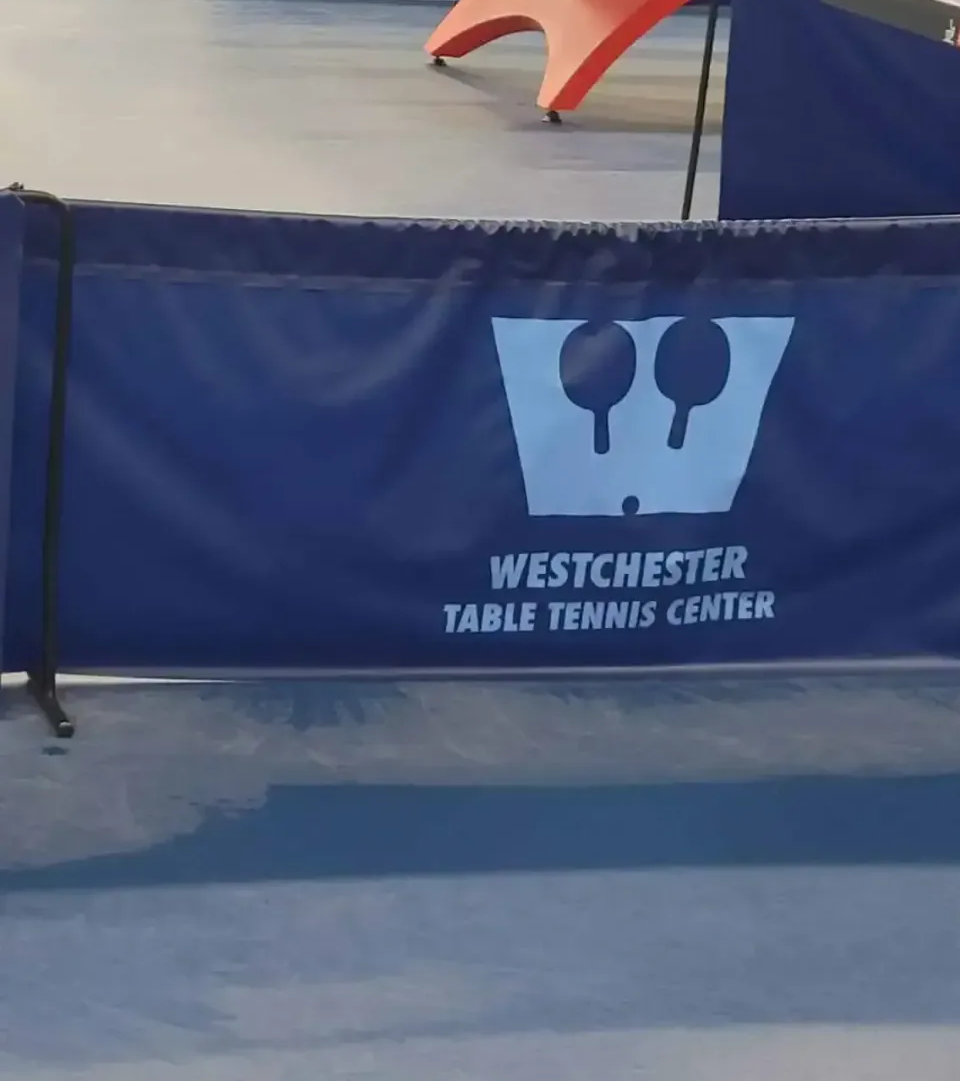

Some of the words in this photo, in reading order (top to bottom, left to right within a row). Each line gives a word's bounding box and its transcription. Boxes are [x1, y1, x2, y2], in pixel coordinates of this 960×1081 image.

[489, 545, 749, 590] WESTCHESTER
[443, 602, 537, 633] TABLE
[548, 600, 658, 631] TENNIS
[666, 590, 776, 625] CENTER
